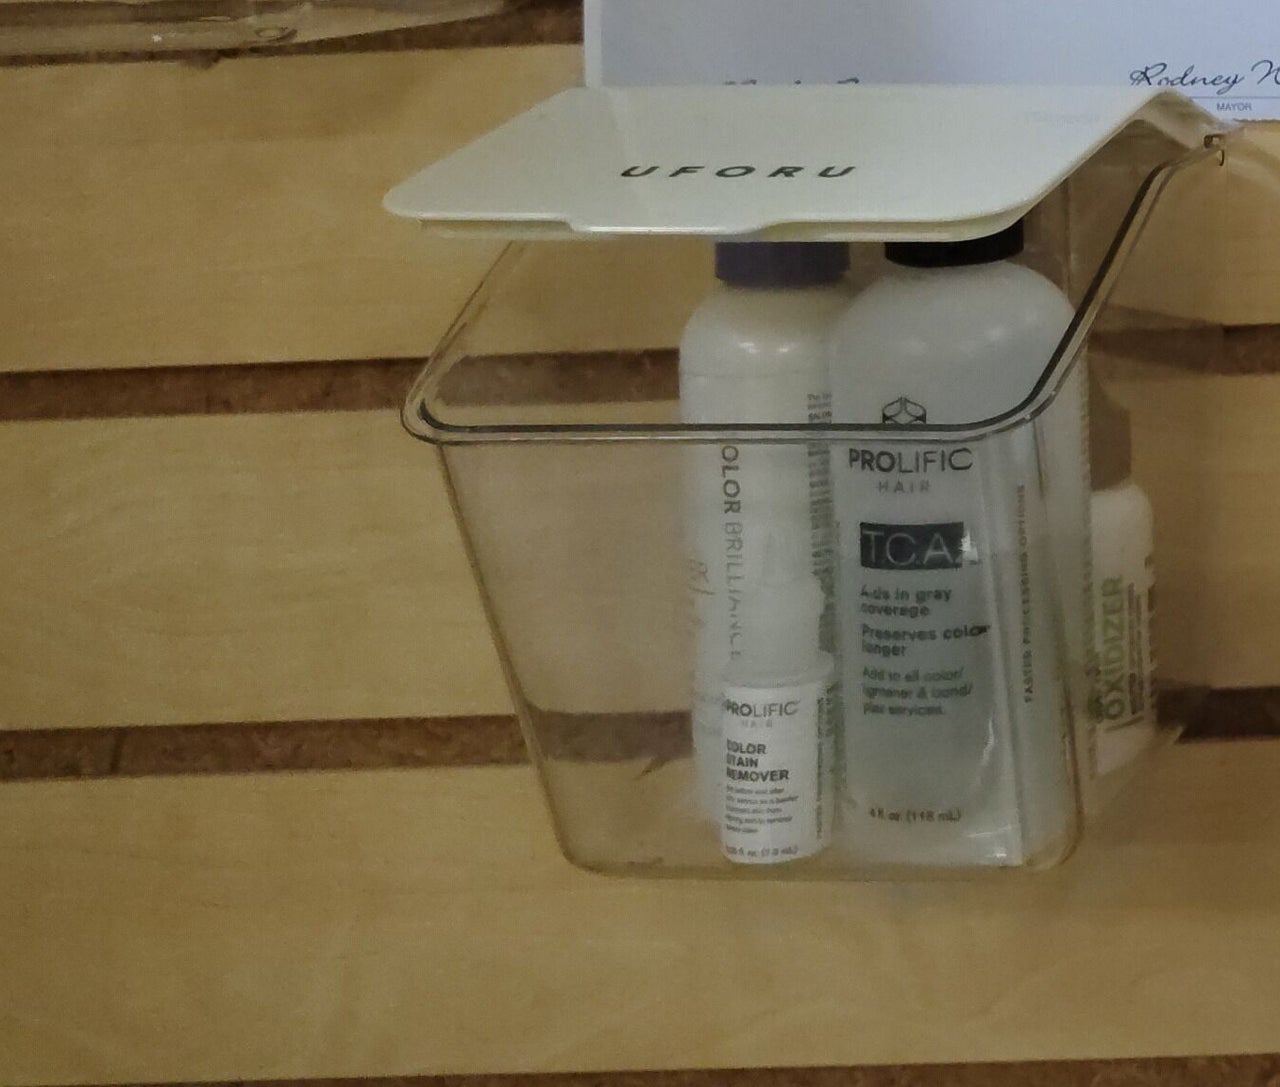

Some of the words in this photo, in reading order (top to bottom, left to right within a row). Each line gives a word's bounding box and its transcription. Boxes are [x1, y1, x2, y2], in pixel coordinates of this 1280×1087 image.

[1129, 62, 1246, 96] Rodney
[1216, 102, 1253, 112] MAYOR
[620, 165, 857, 178] UFORU
[849, 447, 974, 474] PROLIFIC
[721, 445, 742, 514] OLOR
[878, 480, 931, 494] HAIR
[916, 589, 953, 605] gray
